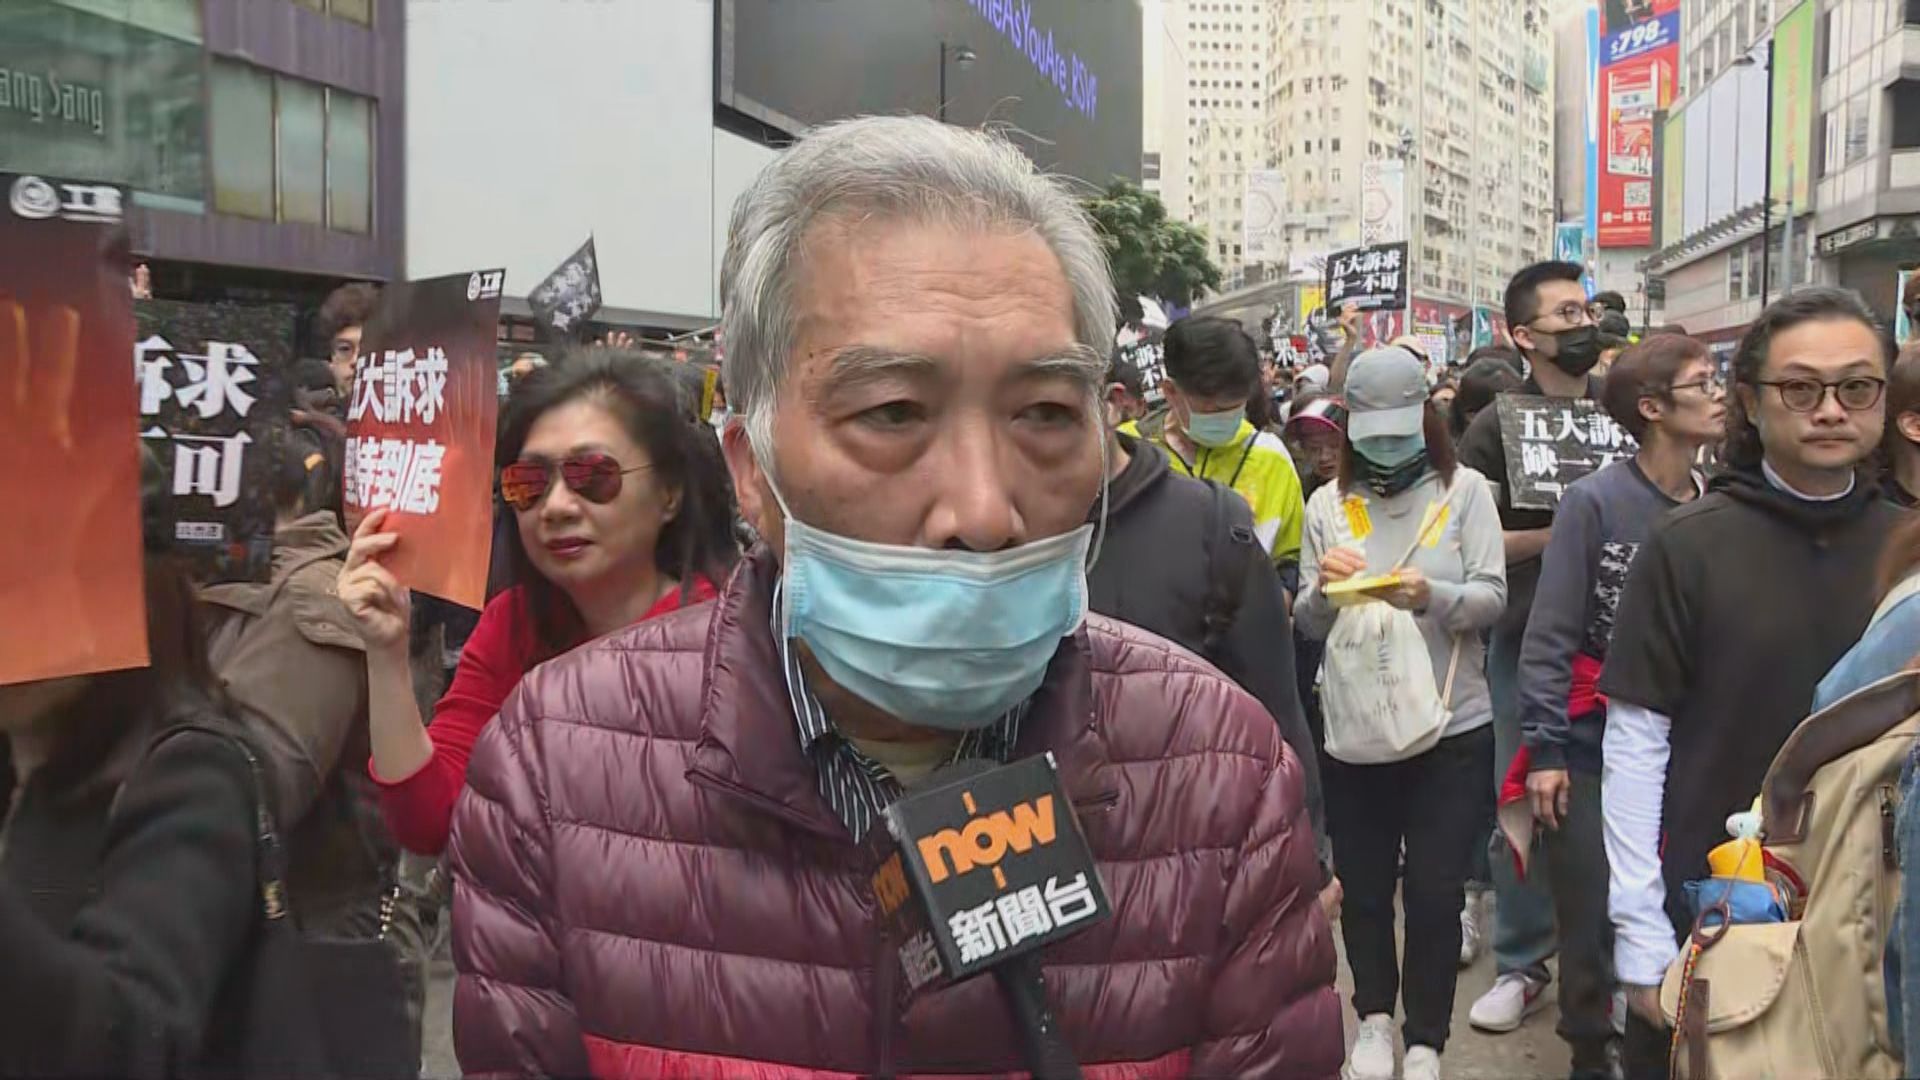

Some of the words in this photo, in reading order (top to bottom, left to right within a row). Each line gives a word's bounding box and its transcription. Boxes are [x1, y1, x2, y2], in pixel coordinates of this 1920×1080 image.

[1611, 19, 1660, 55] $798
[49, 70, 104, 135] Sang
[1332, 249, 1401, 278] 五大訴求
[138, 425, 253, 508] 可
[917, 793, 1057, 884] now
[948, 871, 1098, 964] 新聞台
